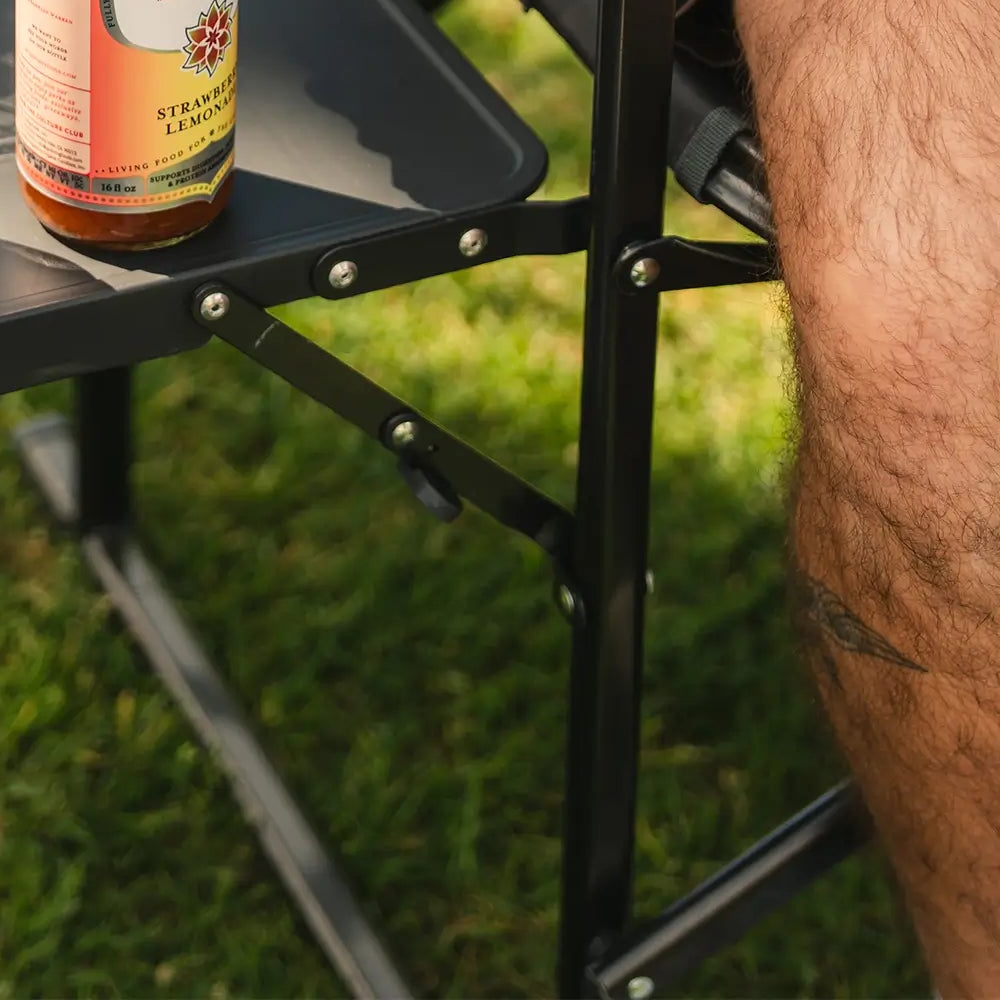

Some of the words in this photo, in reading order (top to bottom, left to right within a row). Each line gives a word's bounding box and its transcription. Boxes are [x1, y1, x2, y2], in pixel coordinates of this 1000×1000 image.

[64, 126, 84, 138] CLUB
[108, 162, 149, 174] LIVING
[155, 149, 184, 167] FOOD
[188, 136, 206, 152] FOR
[149, 166, 191, 184] SUPPORTS
[101, 183, 113, 193] 16
[114, 182, 121, 193] fl
[124, 185, 136, 193] oz
